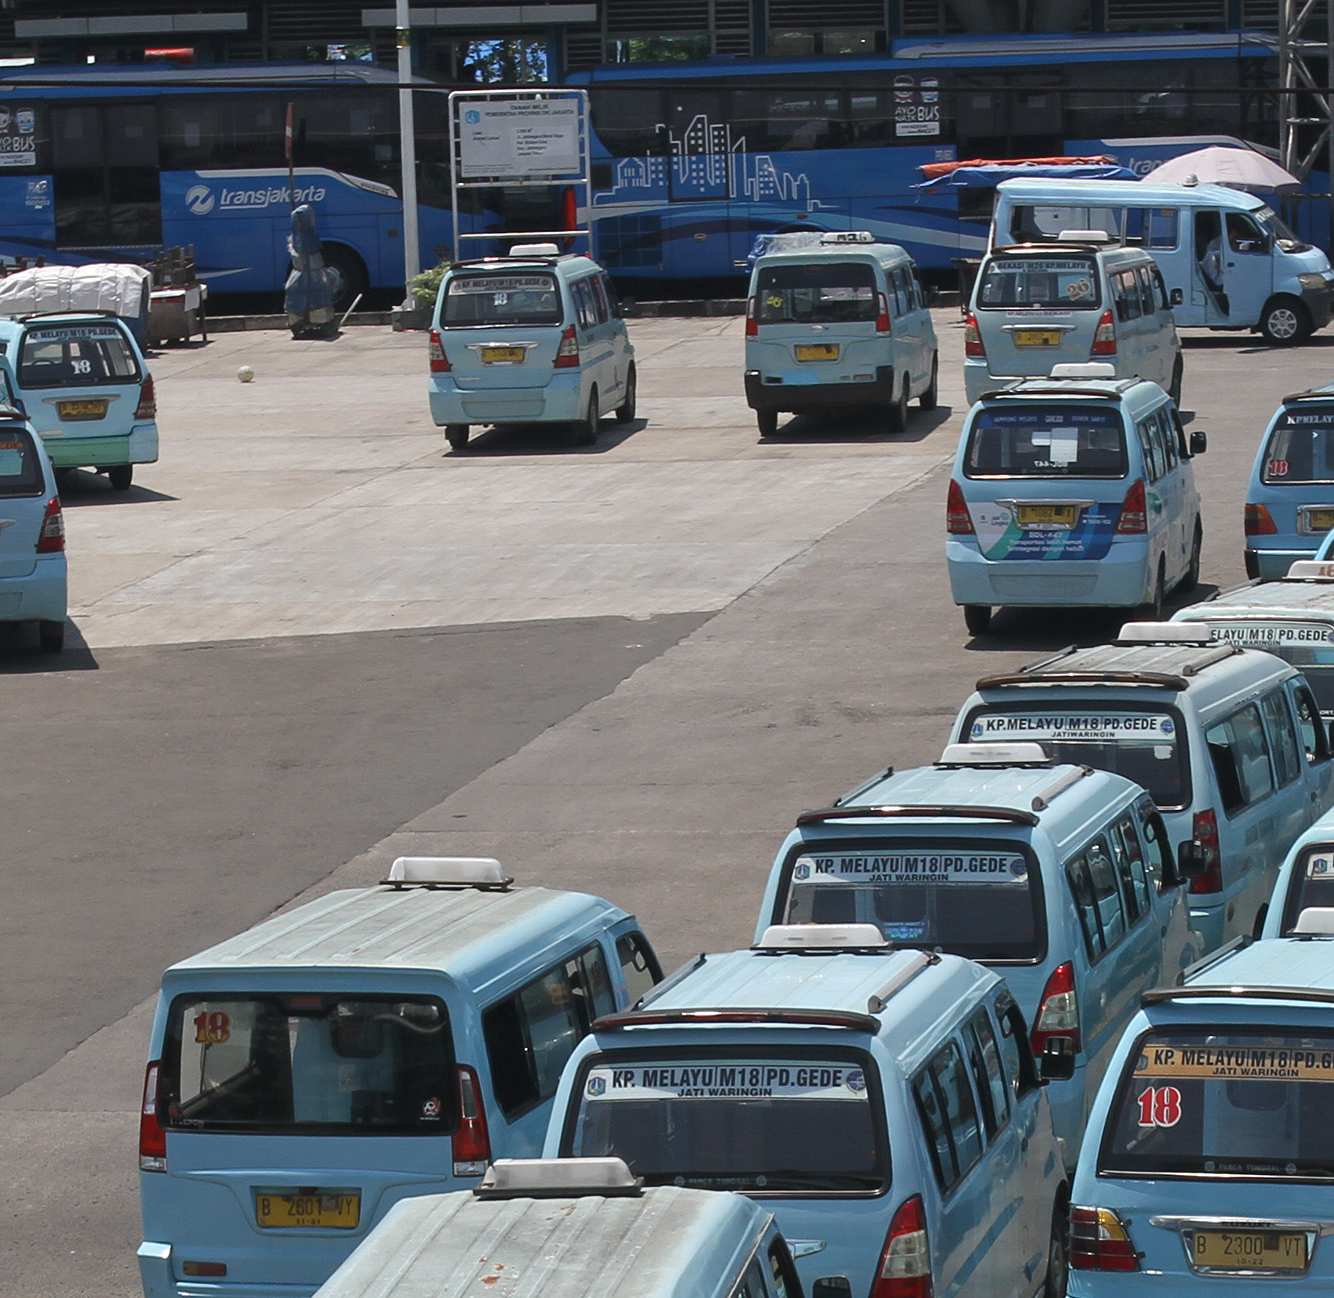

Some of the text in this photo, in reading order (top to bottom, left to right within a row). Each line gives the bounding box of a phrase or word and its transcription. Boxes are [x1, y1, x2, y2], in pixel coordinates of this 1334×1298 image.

[895, 106, 916, 115] AYO
[917, 106, 939, 121] BUS
[13, 136, 35, 152] BUS
[220, 186, 326, 209] transjakarta
[1068, 278, 1091, 301] 26
[493, 293, 508, 306] 18
[71, 359, 92, 375] 18
[1269, 460, 1289, 476] 18
[1249, 628, 1328, 642] M18 PD.GEDE
[986, 717, 1157, 732] KP.MELAYU M18 PD.GEDE
[815, 857, 1007, 874] KP. MELAYU M18 PD.GEDE
[869, 873, 949, 882] JATI WARINGIN
[193, 1011, 230, 1044] 18
[1153, 1048, 1175, 1066] KP.
[1181, 1049, 1248, 1067] MELAYU
[1251, 1050, 1288, 1068] M18
[612, 1068, 842, 1088] KP. MELAYU M18 PD.GEDE
[1212, 1067, 1299, 1077] JATI WARINGIN
[677, 1088, 773, 1098] JATI WARINGIN
[1137, 1086, 1181, 1128] 18
[261, 1197, 323, 1216] B 2601
[1197, 1235, 1302, 1257] B 2300 VT
